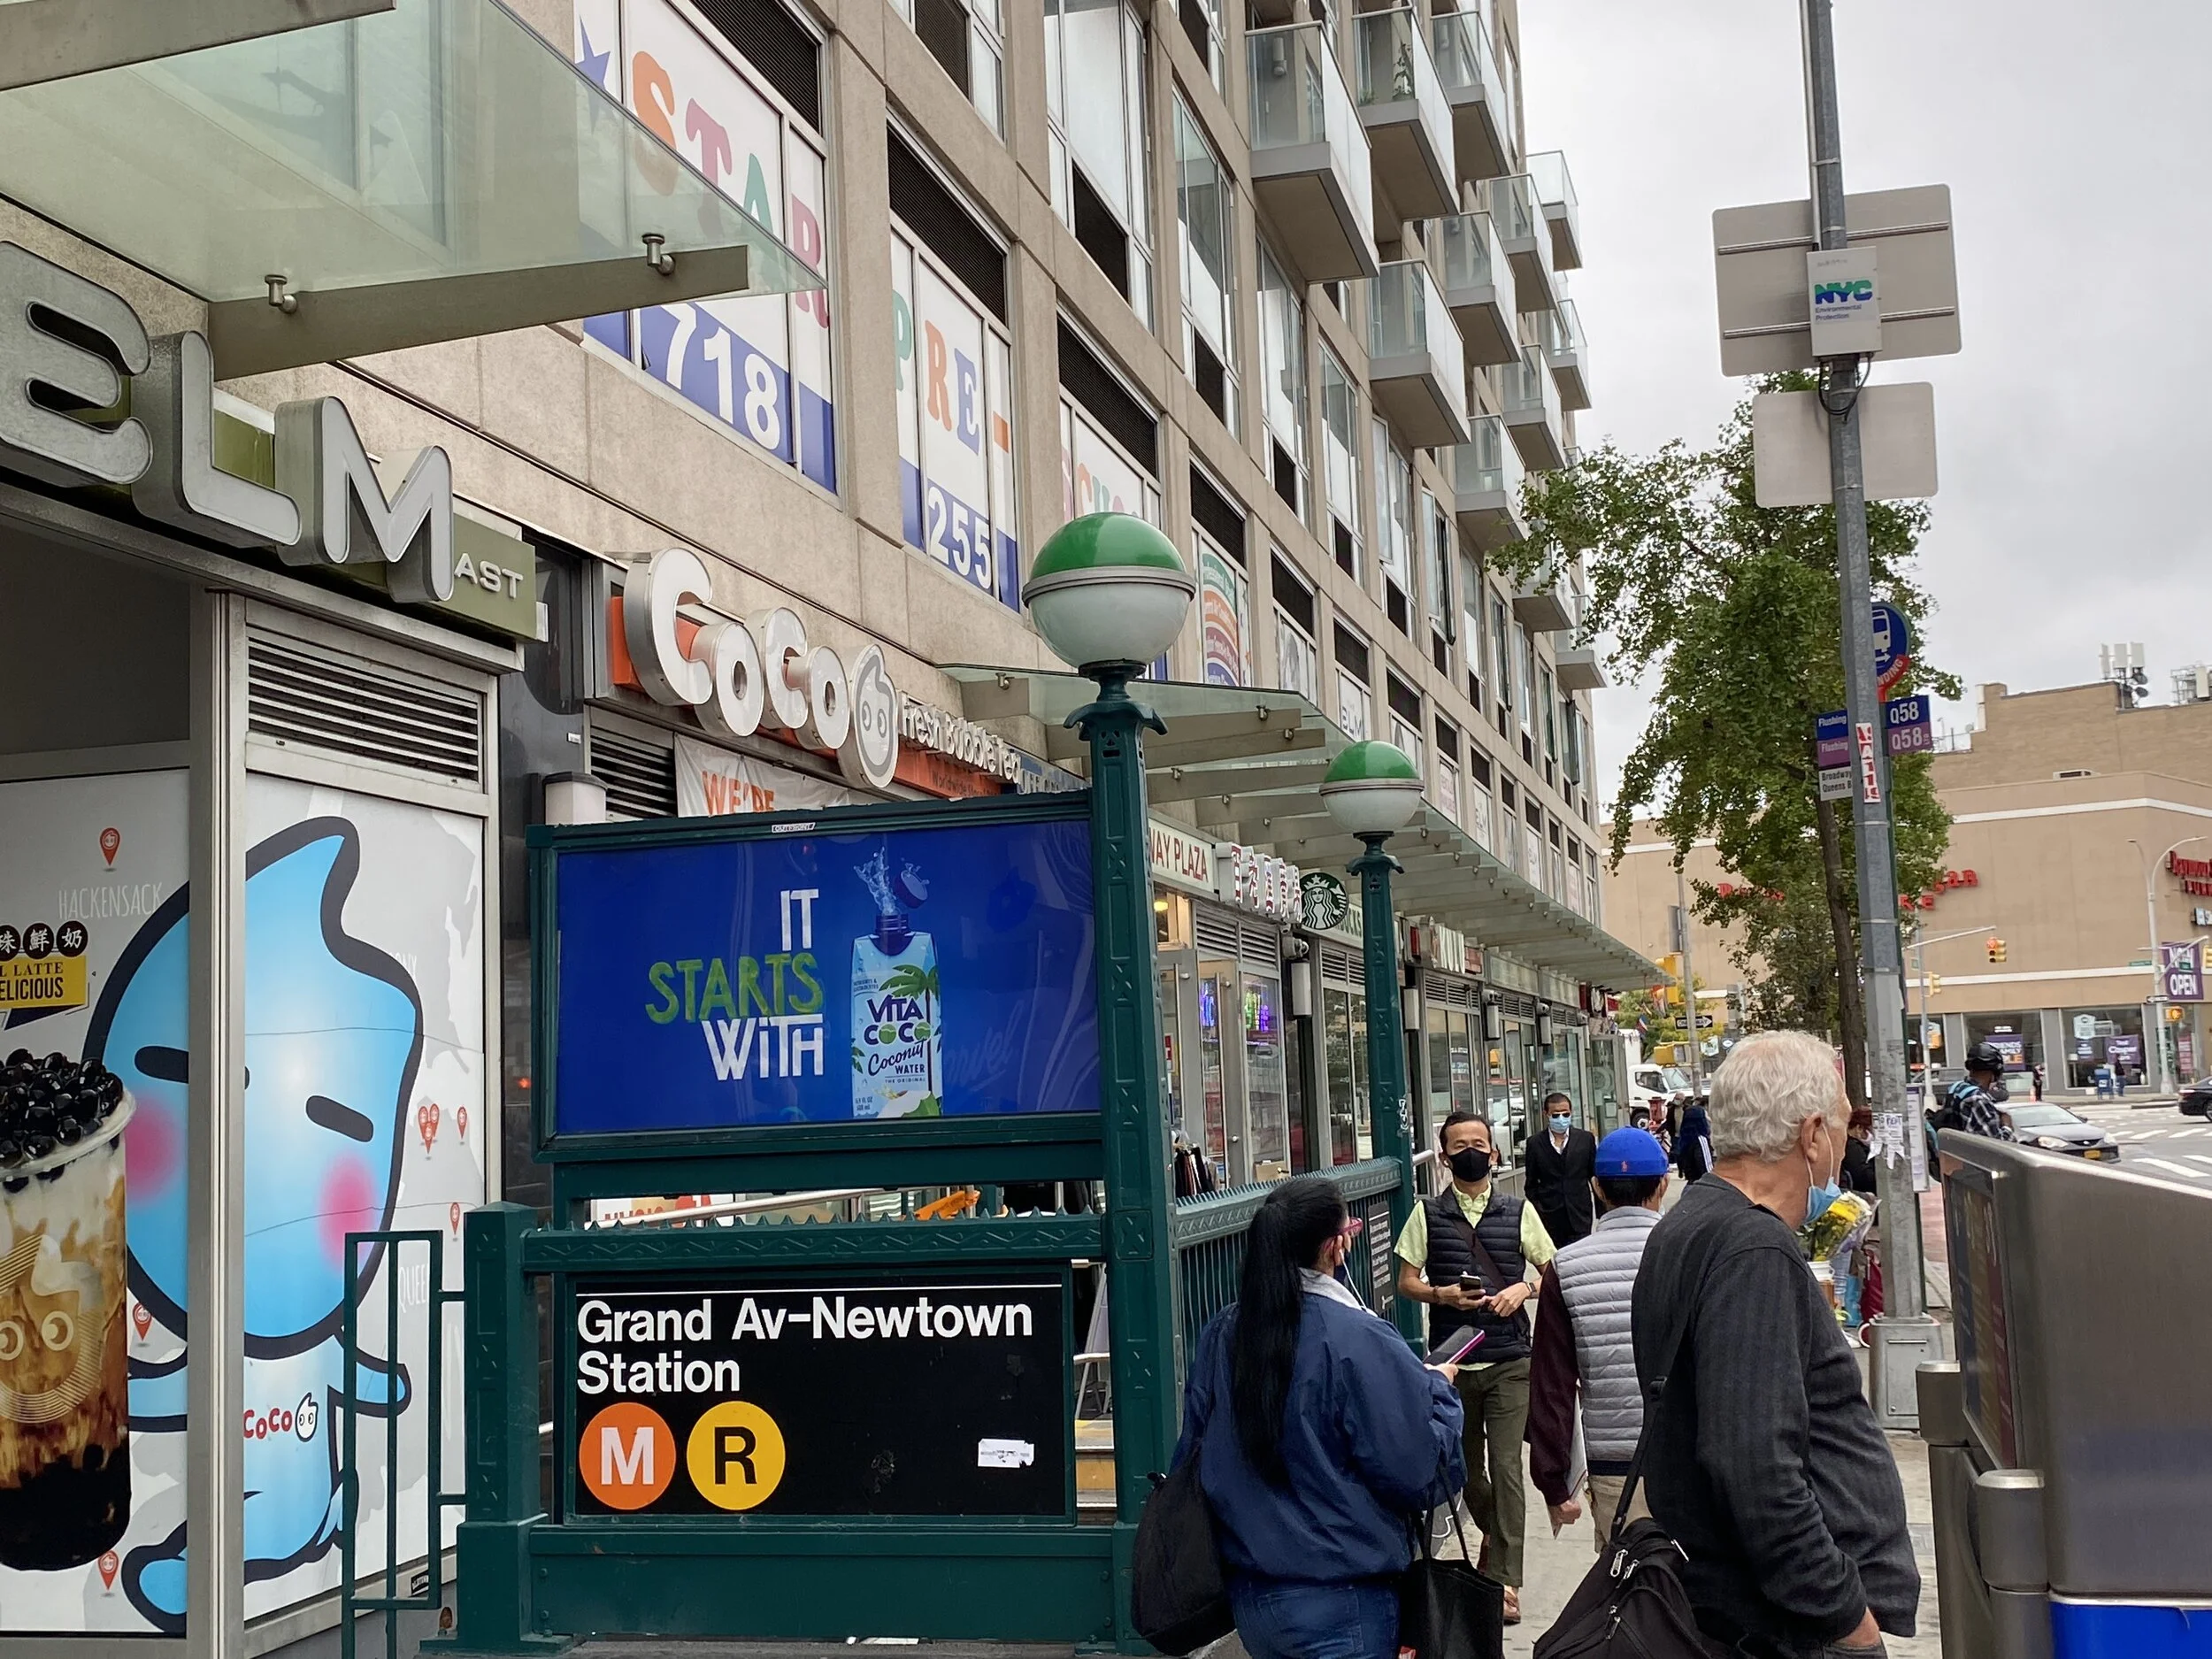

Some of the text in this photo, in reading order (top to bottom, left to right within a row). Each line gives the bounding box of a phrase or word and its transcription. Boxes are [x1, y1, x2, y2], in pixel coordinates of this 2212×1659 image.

[1814, 280, 1873, 304] NYC
[649, 299, 782, 451] 718
[0, 240, 525, 602] ELM AST
[926, 485, 994, 590] 255
[1877, 657, 1904, 686] NDING
[1818, 715, 1847, 727] Flushing
[1890, 701, 1920, 724] Q58
[1821, 741, 1849, 753] Flushing
[1892, 726, 1923, 750] Q58
[1822, 771, 1853, 782] Broadway
[1823, 781, 1847, 793] Queens
[1173, 836, 1209, 883] PLAZA
[58, 882, 164, 921] HACKENSACK
[780, 888, 819, 951] IT
[13, 961, 65, 977] LATTE
[0, 976, 64, 1002] ELICIOUS
[645, 952, 825, 1025] STARTS
[2170, 973, 2198, 995] OPEN
[866, 994, 925, 1024] VITA
[863, 1021, 932, 1047] COCO
[867, 1039, 926, 1077] Coconut
[895, 1064, 926, 1075] WATER
[576, 1299, 713, 1343] Grand
[576, 1350, 741, 1394] Station
[600, 1425, 758, 1486] M R
